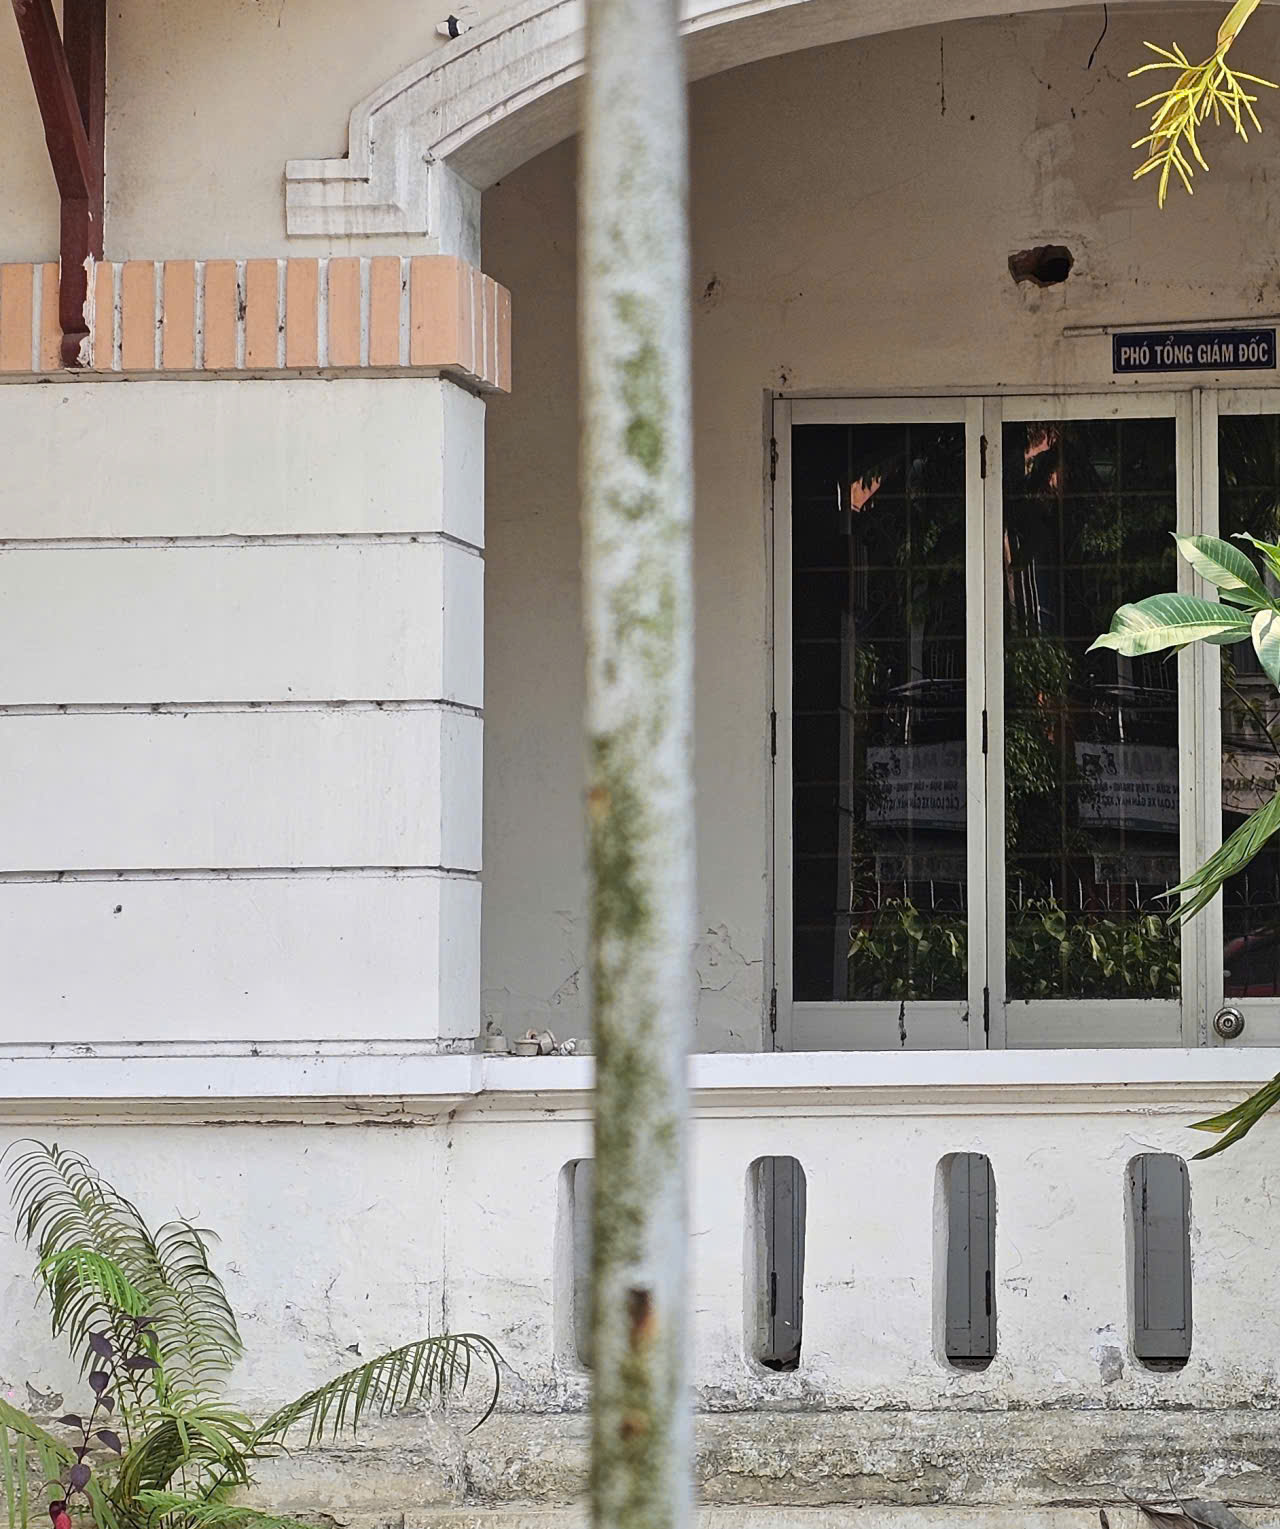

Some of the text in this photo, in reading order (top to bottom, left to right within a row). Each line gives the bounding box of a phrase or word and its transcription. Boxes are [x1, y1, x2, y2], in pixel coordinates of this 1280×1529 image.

[1121, 335, 1269, 365] PHÓ TỔNG GIÁM ĐỐC
